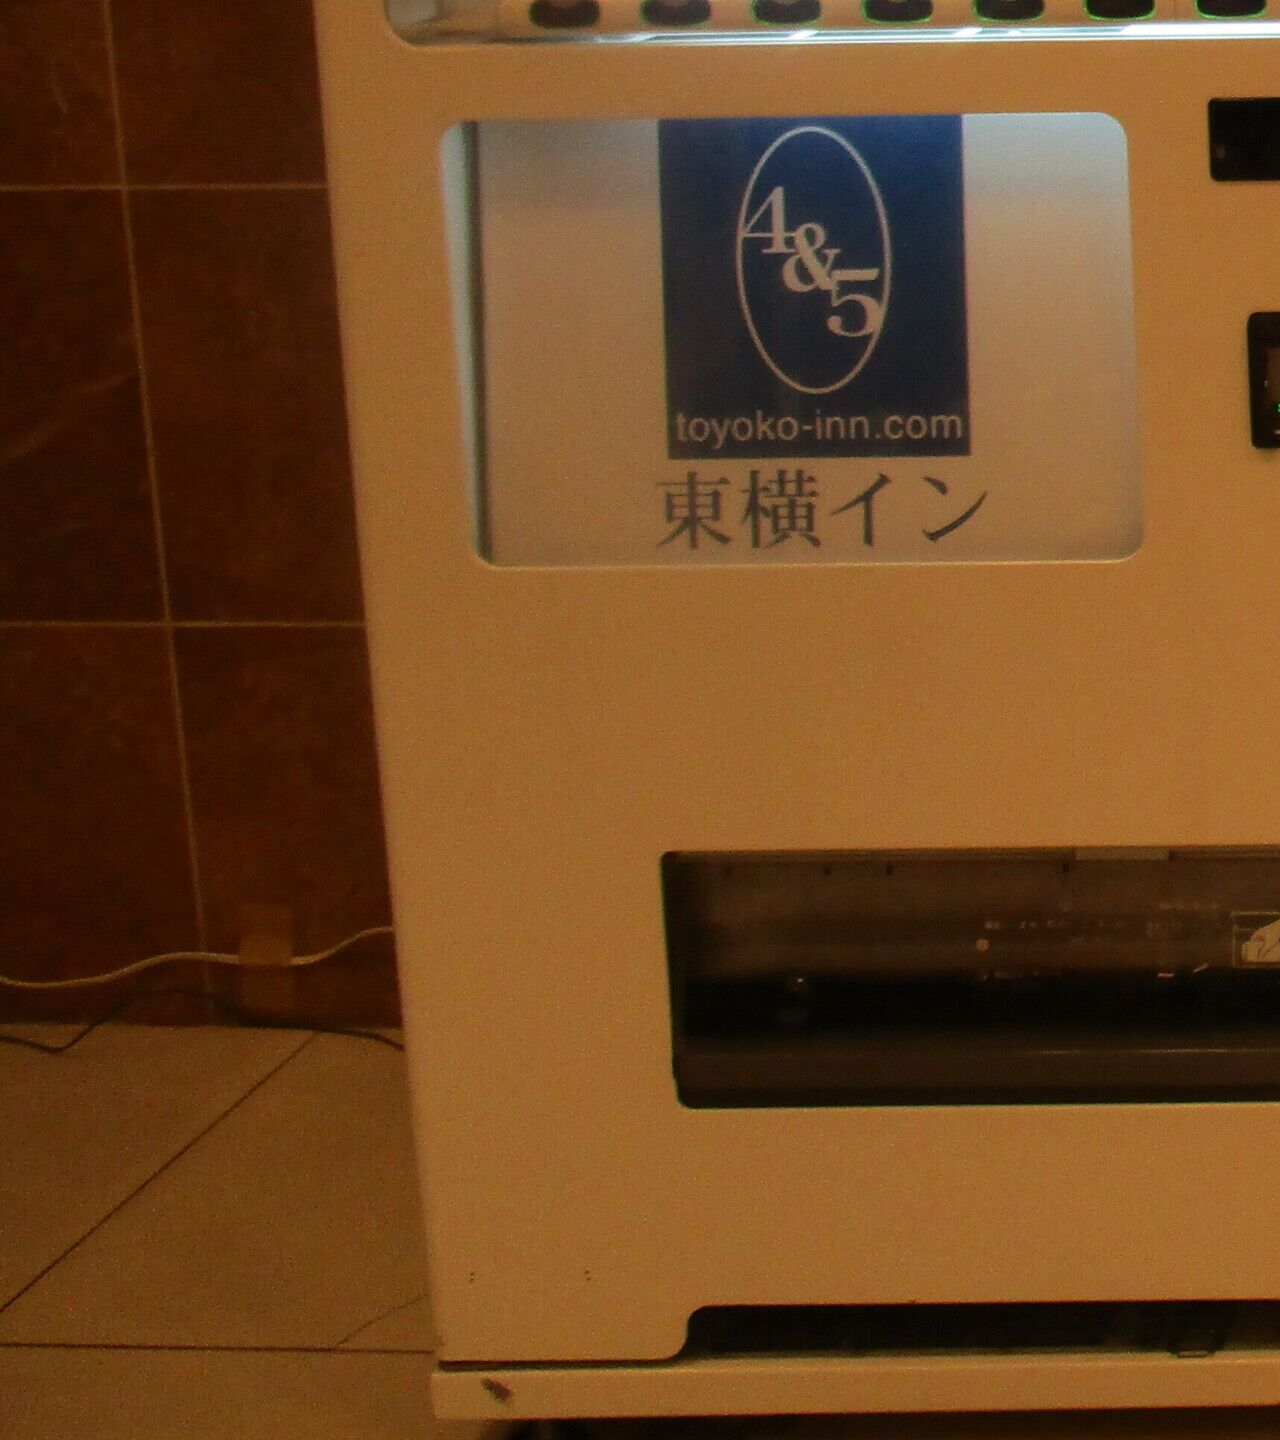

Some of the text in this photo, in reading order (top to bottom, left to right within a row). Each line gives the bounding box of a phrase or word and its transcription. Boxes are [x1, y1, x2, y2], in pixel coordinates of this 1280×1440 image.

[743, 185, 883, 337] 4&5
[675, 409, 964, 450] toyoko-inn.com
[656, 469, 989, 551] 東横イン
